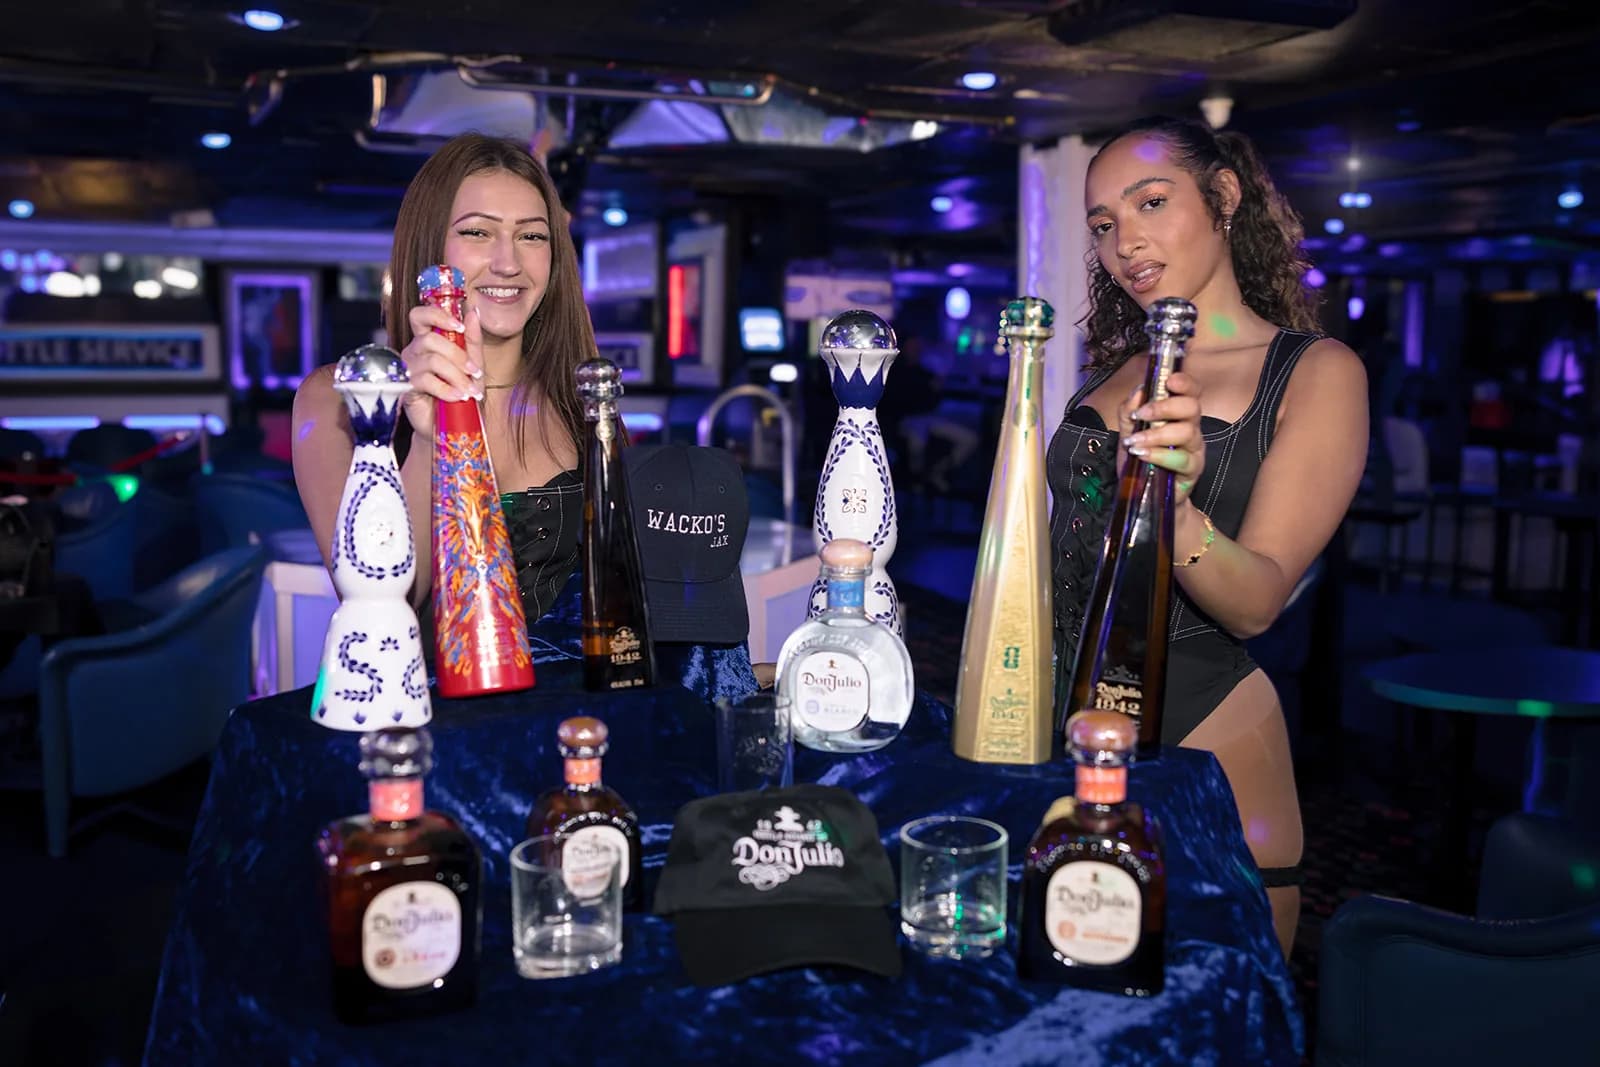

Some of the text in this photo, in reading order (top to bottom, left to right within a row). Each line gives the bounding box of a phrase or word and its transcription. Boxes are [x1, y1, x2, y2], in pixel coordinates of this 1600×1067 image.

[0, 339, 192, 365] TTLE SERVICE
[647, 508, 726, 534] WACKO'S
[710, 535, 729, 548] JAX
[1095, 698, 1142, 716] 1942
